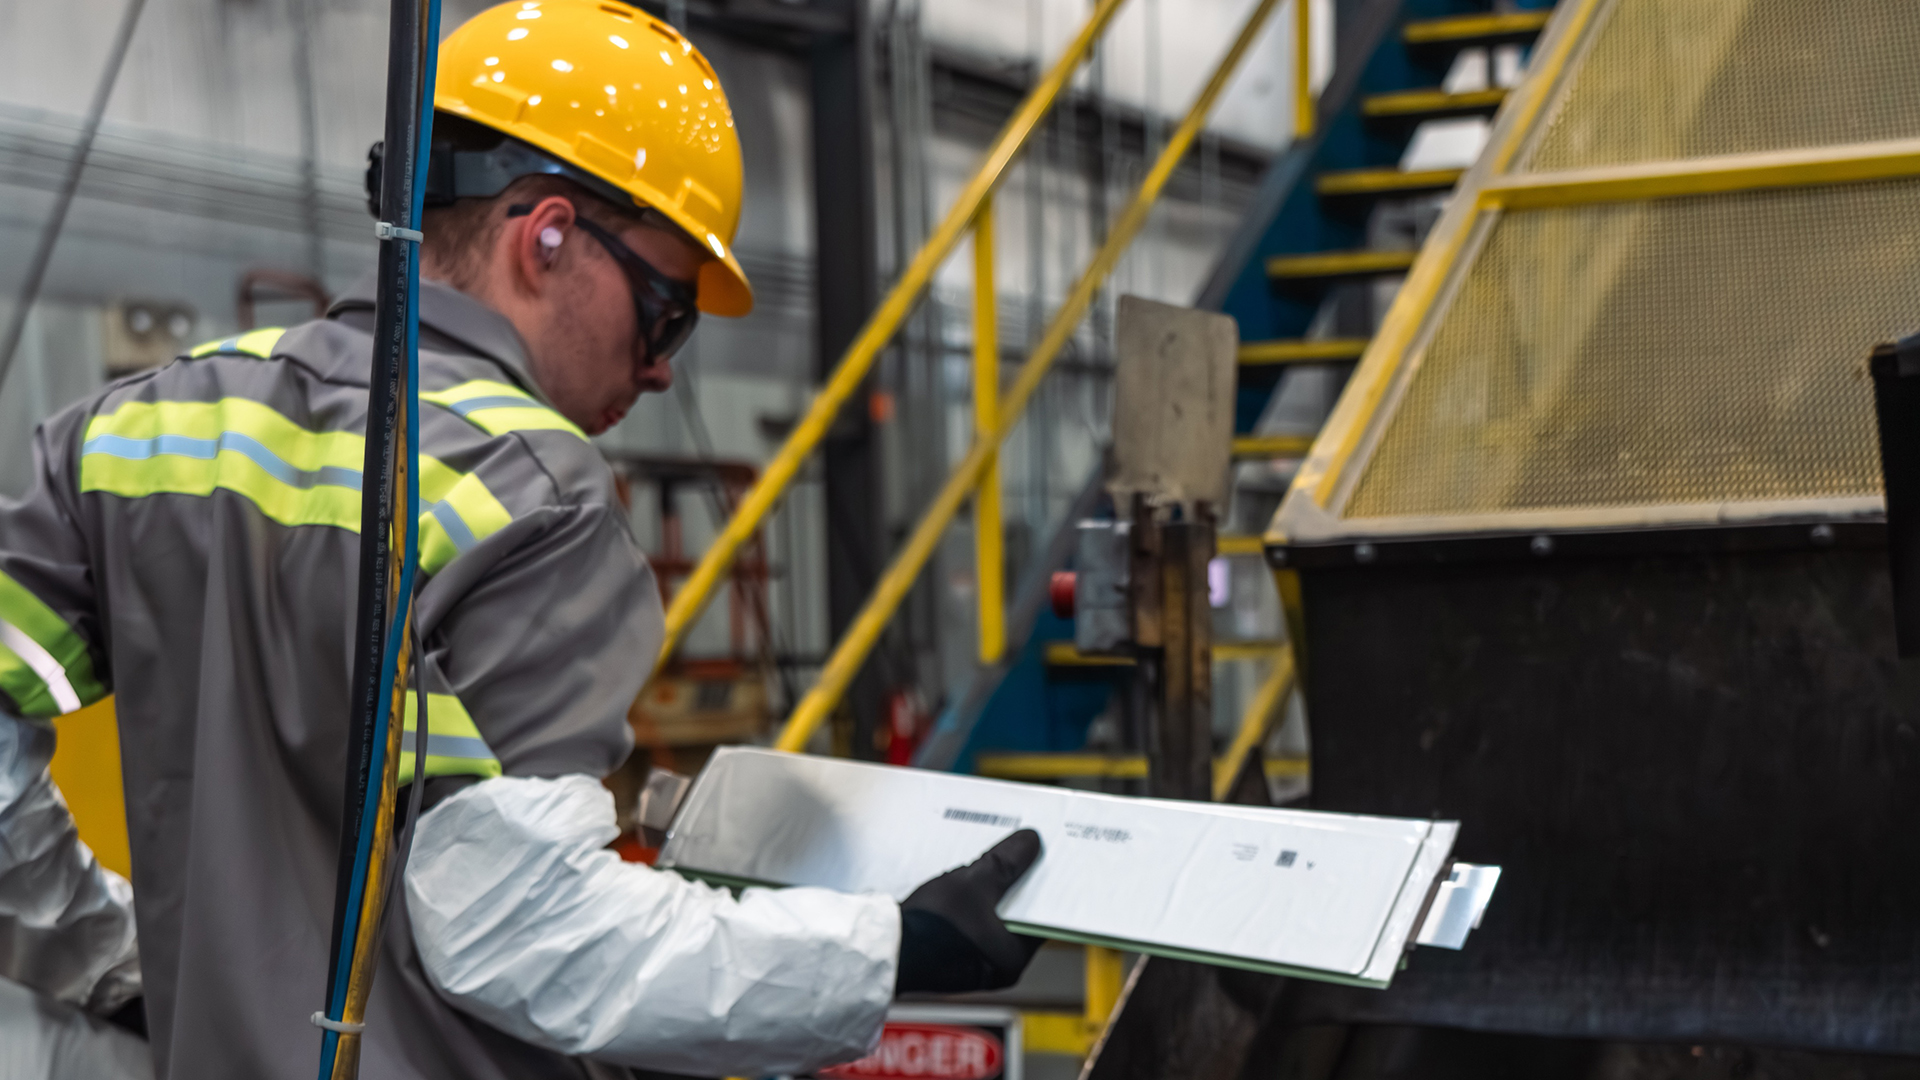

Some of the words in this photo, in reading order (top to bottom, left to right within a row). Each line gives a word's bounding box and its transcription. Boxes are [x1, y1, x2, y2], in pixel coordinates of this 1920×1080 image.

[396, 292, 404, 301] OR
[392, 345, 399, 354] OR
[389, 378, 397, 397] 1000V
[379, 483, 387, 503] TC-ER
[378, 521, 386, 538] 600V
[377, 541, 385, 554] SUN
[376, 556, 384, 569] RES
[375, 571, 383, 584] DIR
[374, 603, 382, 615] OIL
[372, 618, 380, 631] RES
[371, 645, 378, 654] OR
[369, 675, 376, 684] OR
[842, 1032, 987, 1078] NGER
